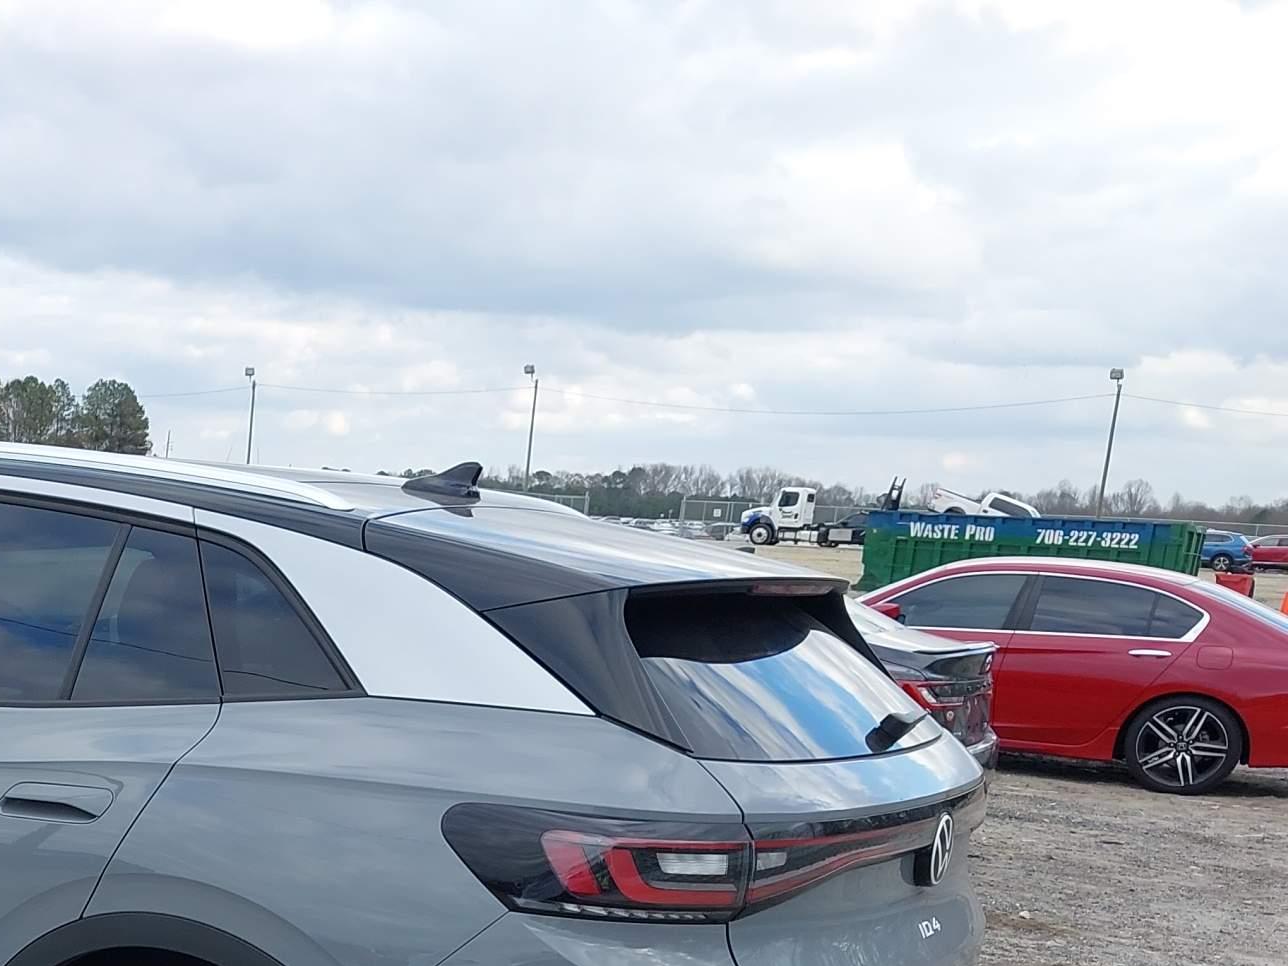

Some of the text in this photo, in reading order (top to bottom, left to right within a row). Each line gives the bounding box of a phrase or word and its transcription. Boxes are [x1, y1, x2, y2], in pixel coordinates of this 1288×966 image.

[910, 521, 995, 541] WASTE PRO
[1035, 528, 1139, 549] 706-227-3222
